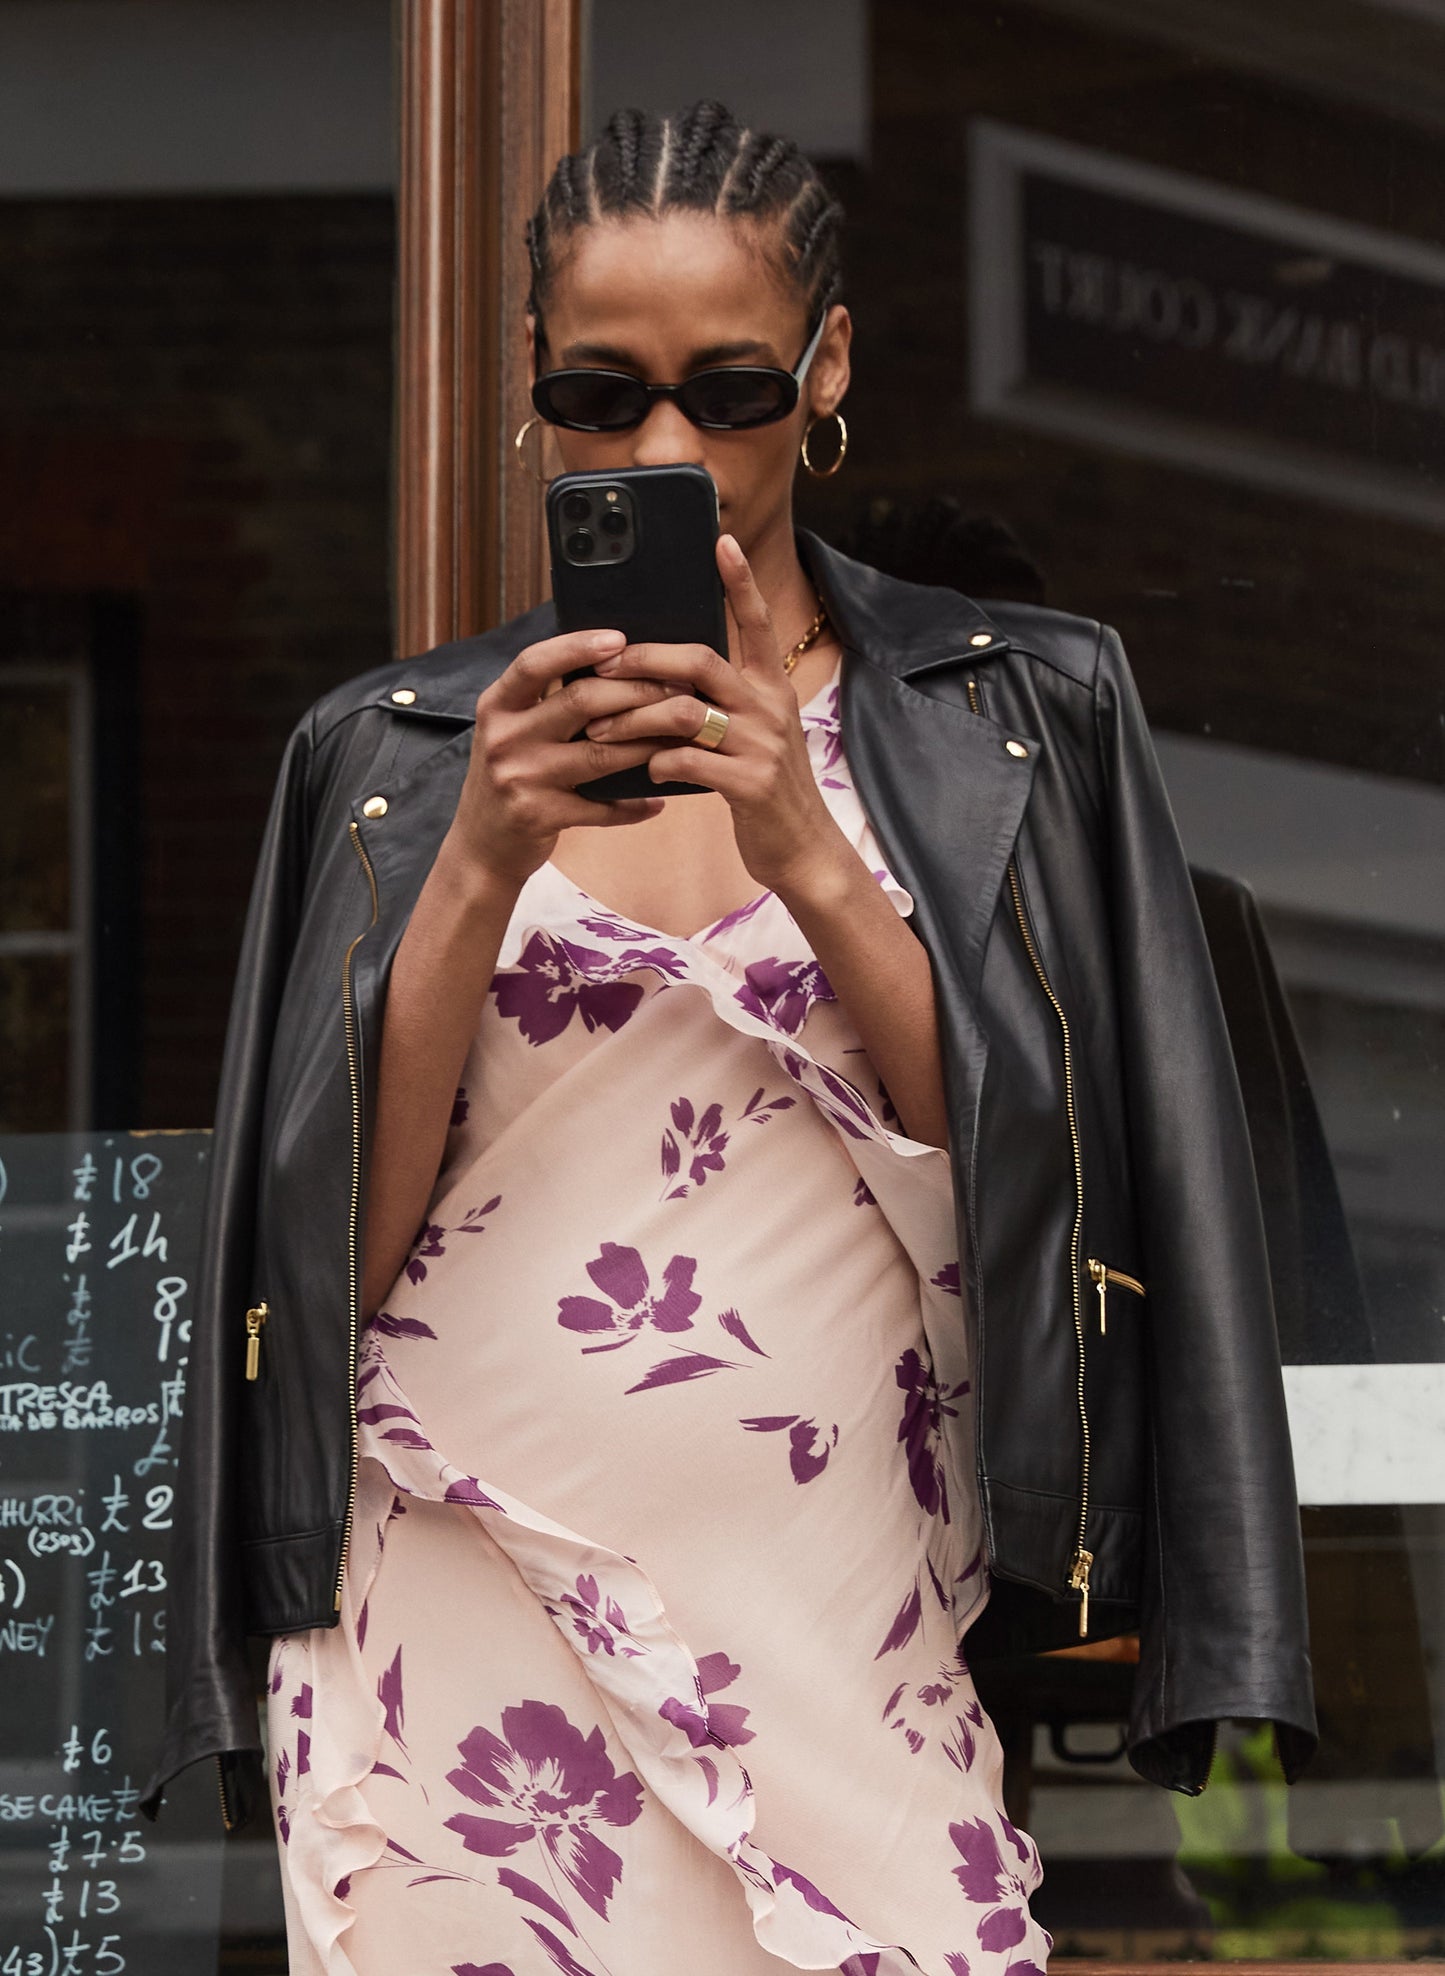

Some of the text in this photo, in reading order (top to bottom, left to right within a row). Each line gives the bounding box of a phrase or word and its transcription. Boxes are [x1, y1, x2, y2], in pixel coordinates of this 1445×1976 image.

[0, 1335, 41, 1373] iC
[0, 1380, 112, 1415] TRESCA
[62, 1402, 160, 1430] BARROS
[0, 1488, 84, 1527] HURRi
